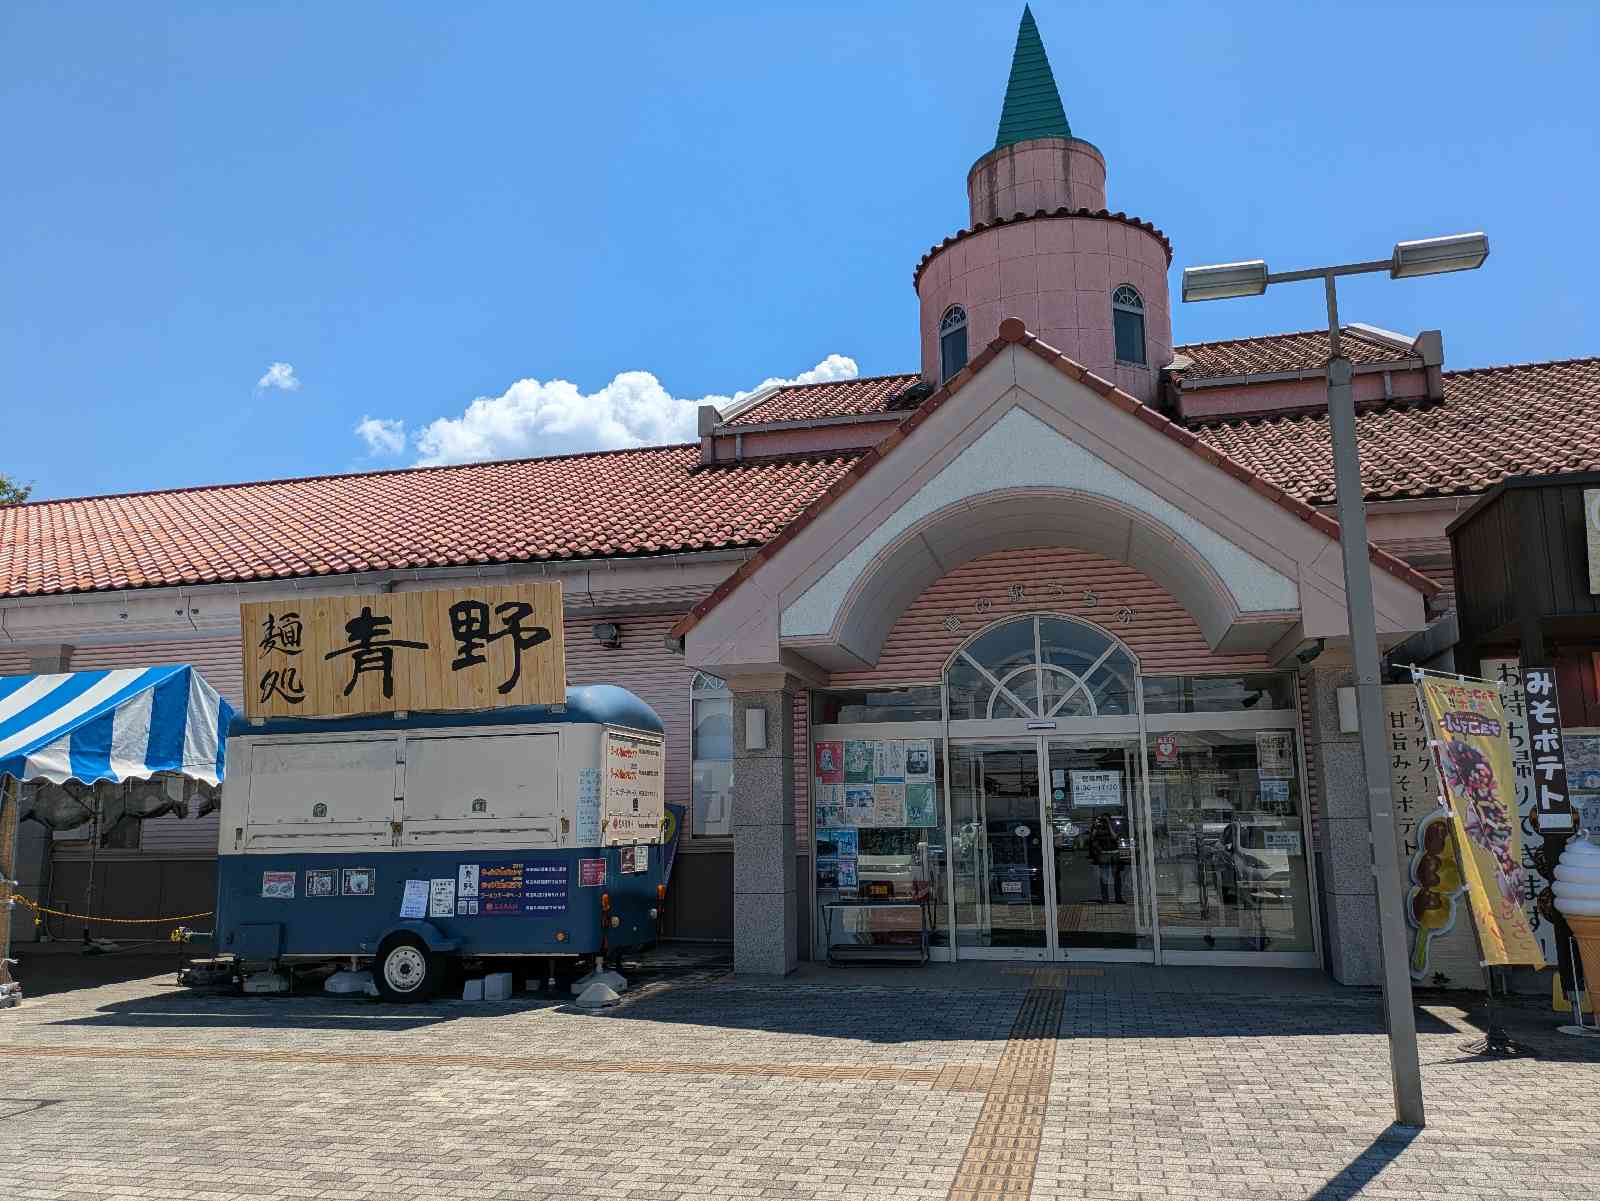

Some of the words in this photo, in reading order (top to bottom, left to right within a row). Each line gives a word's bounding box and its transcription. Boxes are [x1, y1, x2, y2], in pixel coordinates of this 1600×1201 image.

[324, 599, 552, 699] 青野
[1526, 671, 1565, 809] みそポテト
